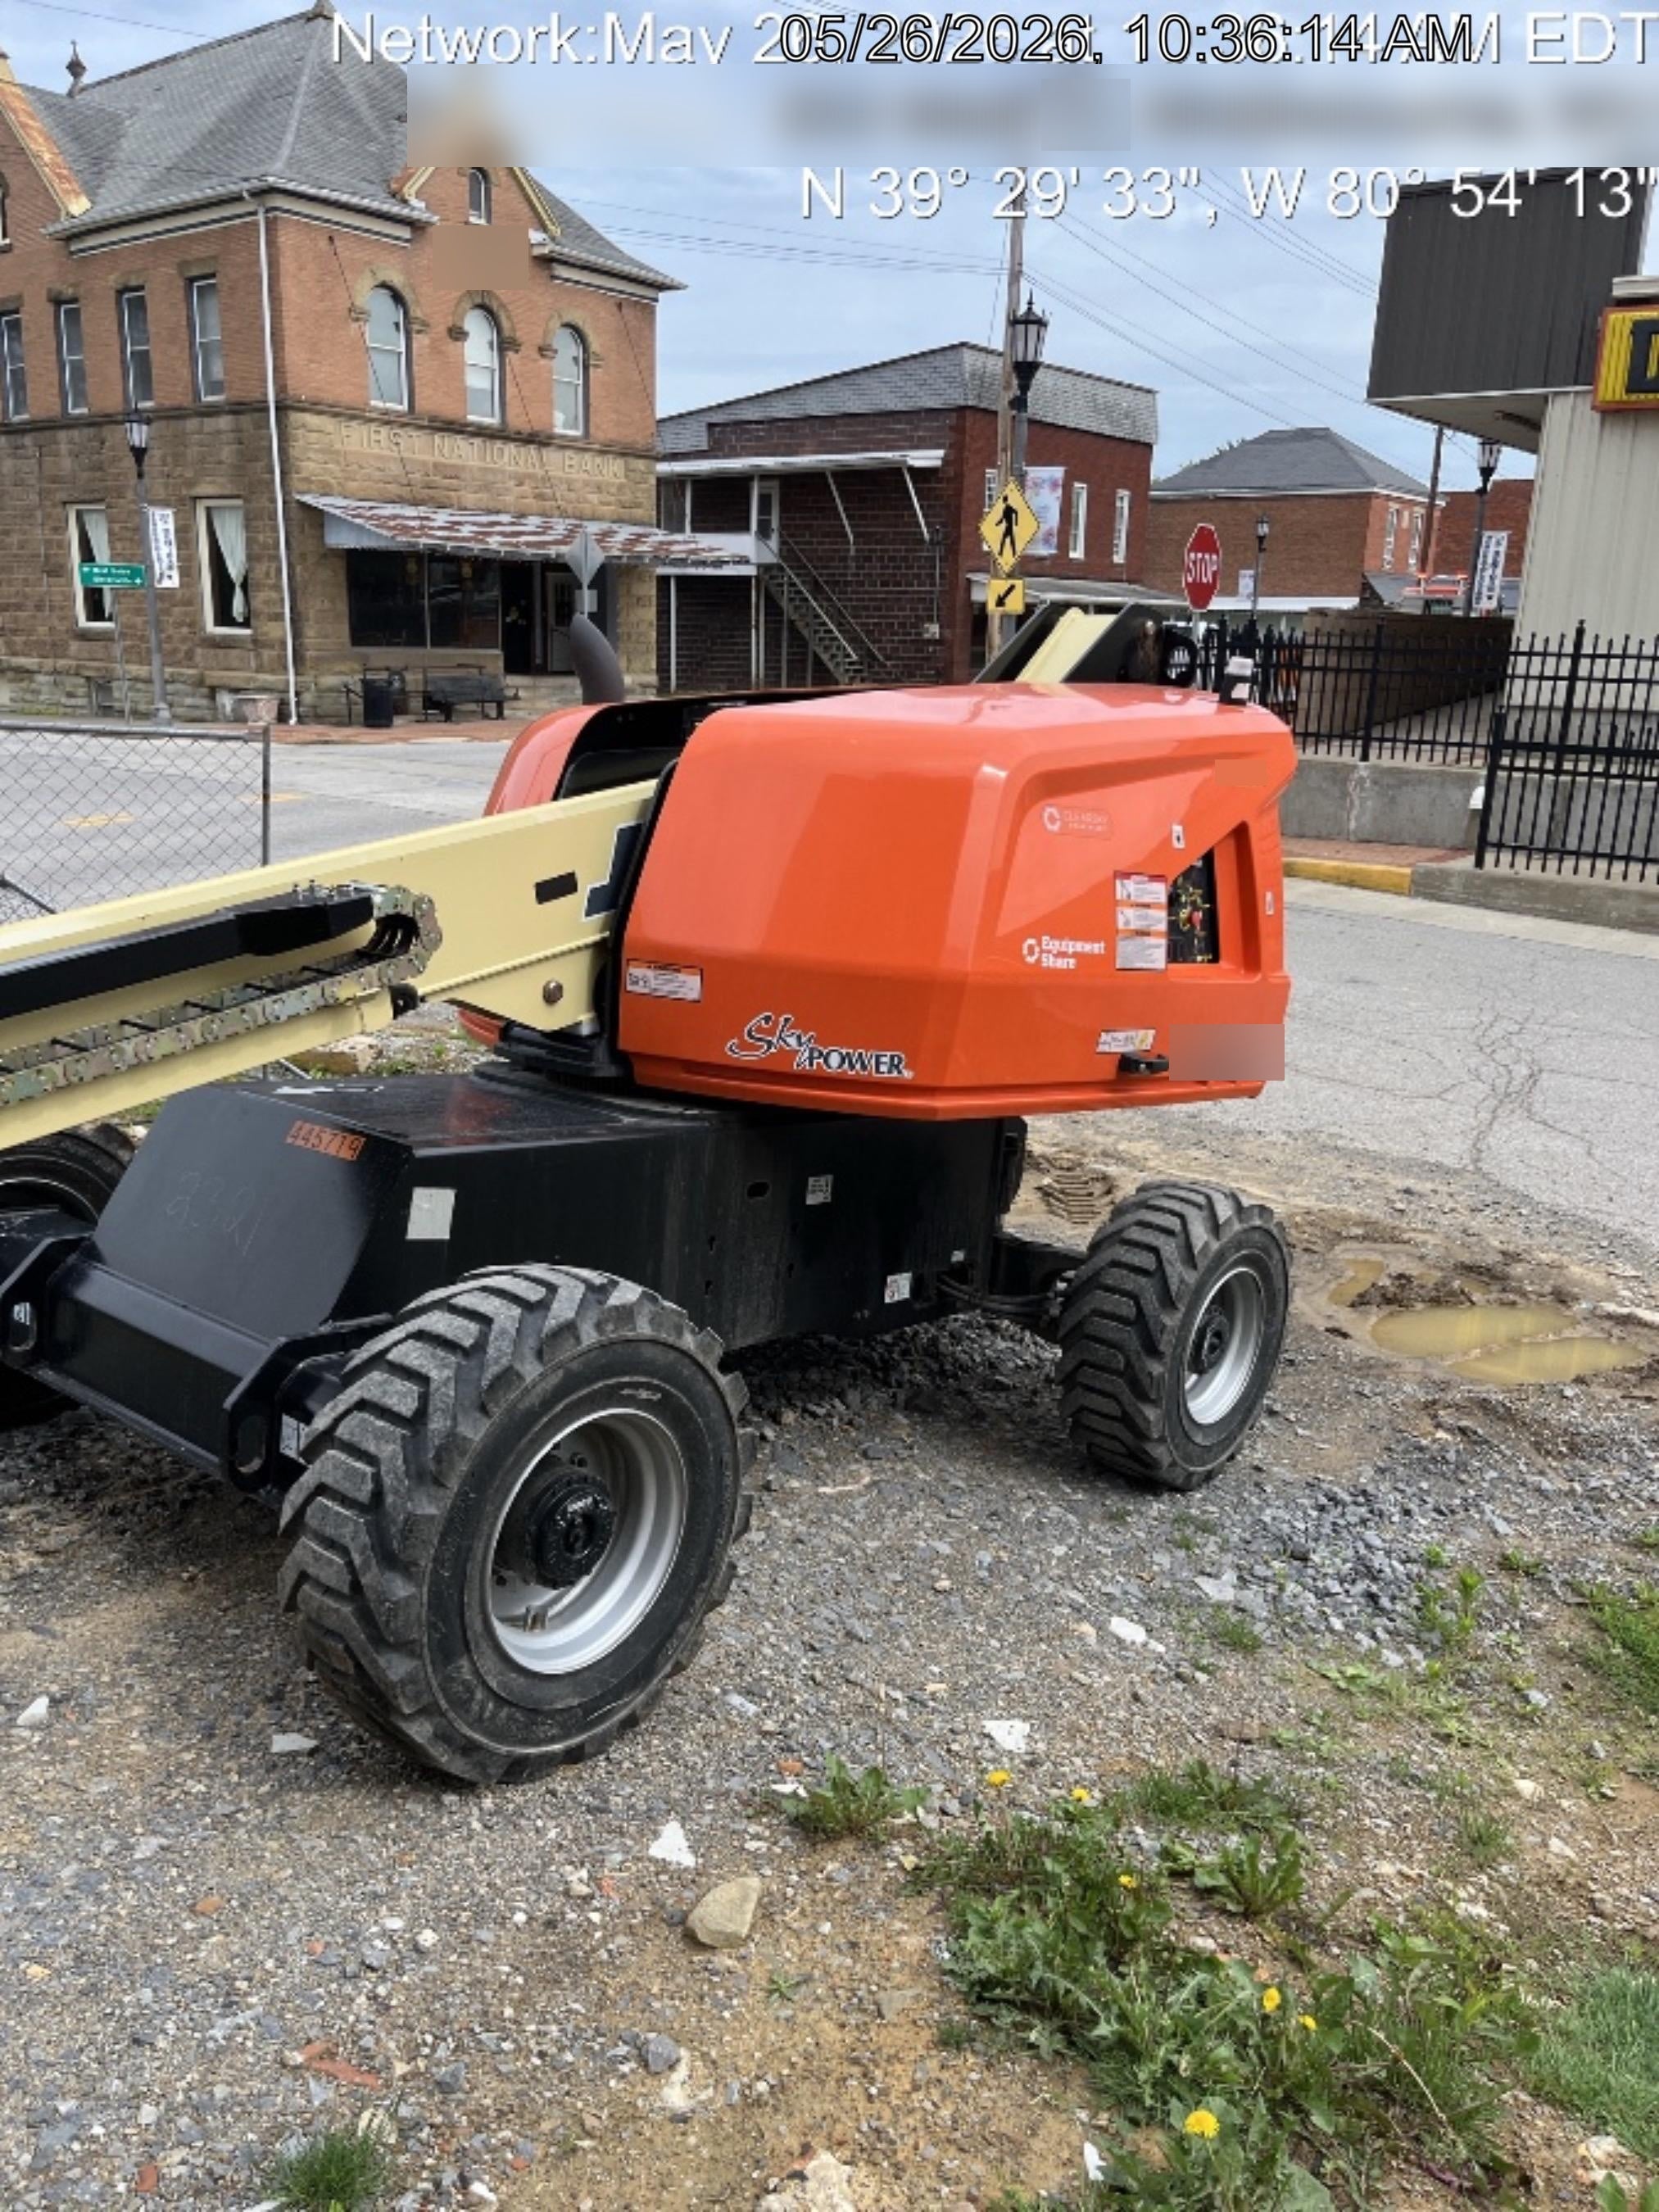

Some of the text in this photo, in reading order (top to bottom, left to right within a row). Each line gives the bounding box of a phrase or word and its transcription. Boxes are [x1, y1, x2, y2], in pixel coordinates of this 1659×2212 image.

[434, 434, 551, 471] NATIONAL
[564, 453, 627, 481] BANK
[1187, 551, 1217, 583] STOP
[806, 1046, 906, 1077] POWER
